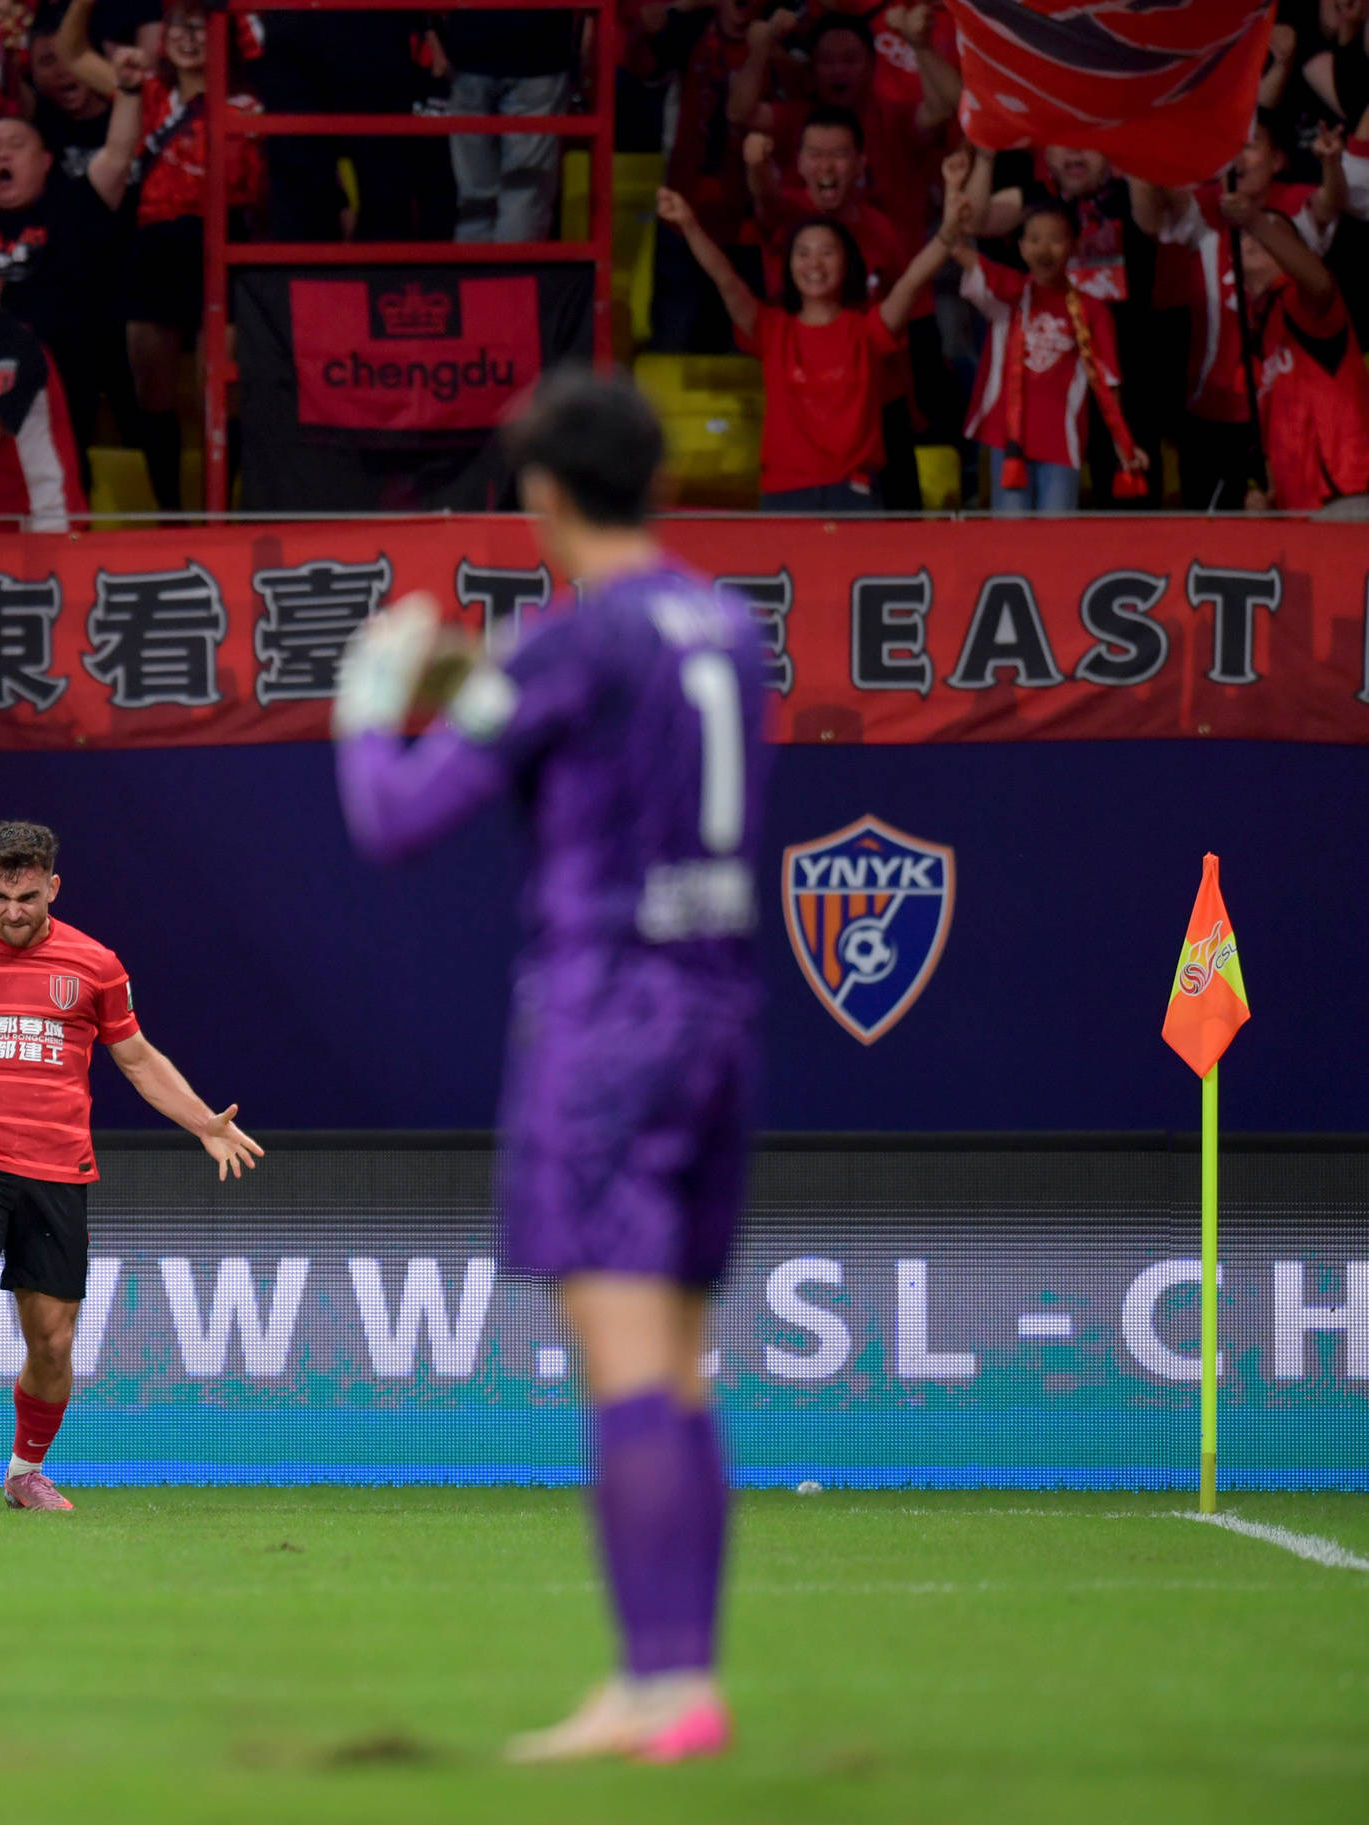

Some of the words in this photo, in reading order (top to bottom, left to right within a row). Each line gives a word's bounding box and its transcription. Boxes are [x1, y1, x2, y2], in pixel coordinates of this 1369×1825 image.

[324, 347, 514, 402] chengdu
[457, 556, 795, 697] TE
[850, 558, 1282, 697] EAST
[678, 650, 745, 856] 1
[798, 856, 936, 889] YNYK
